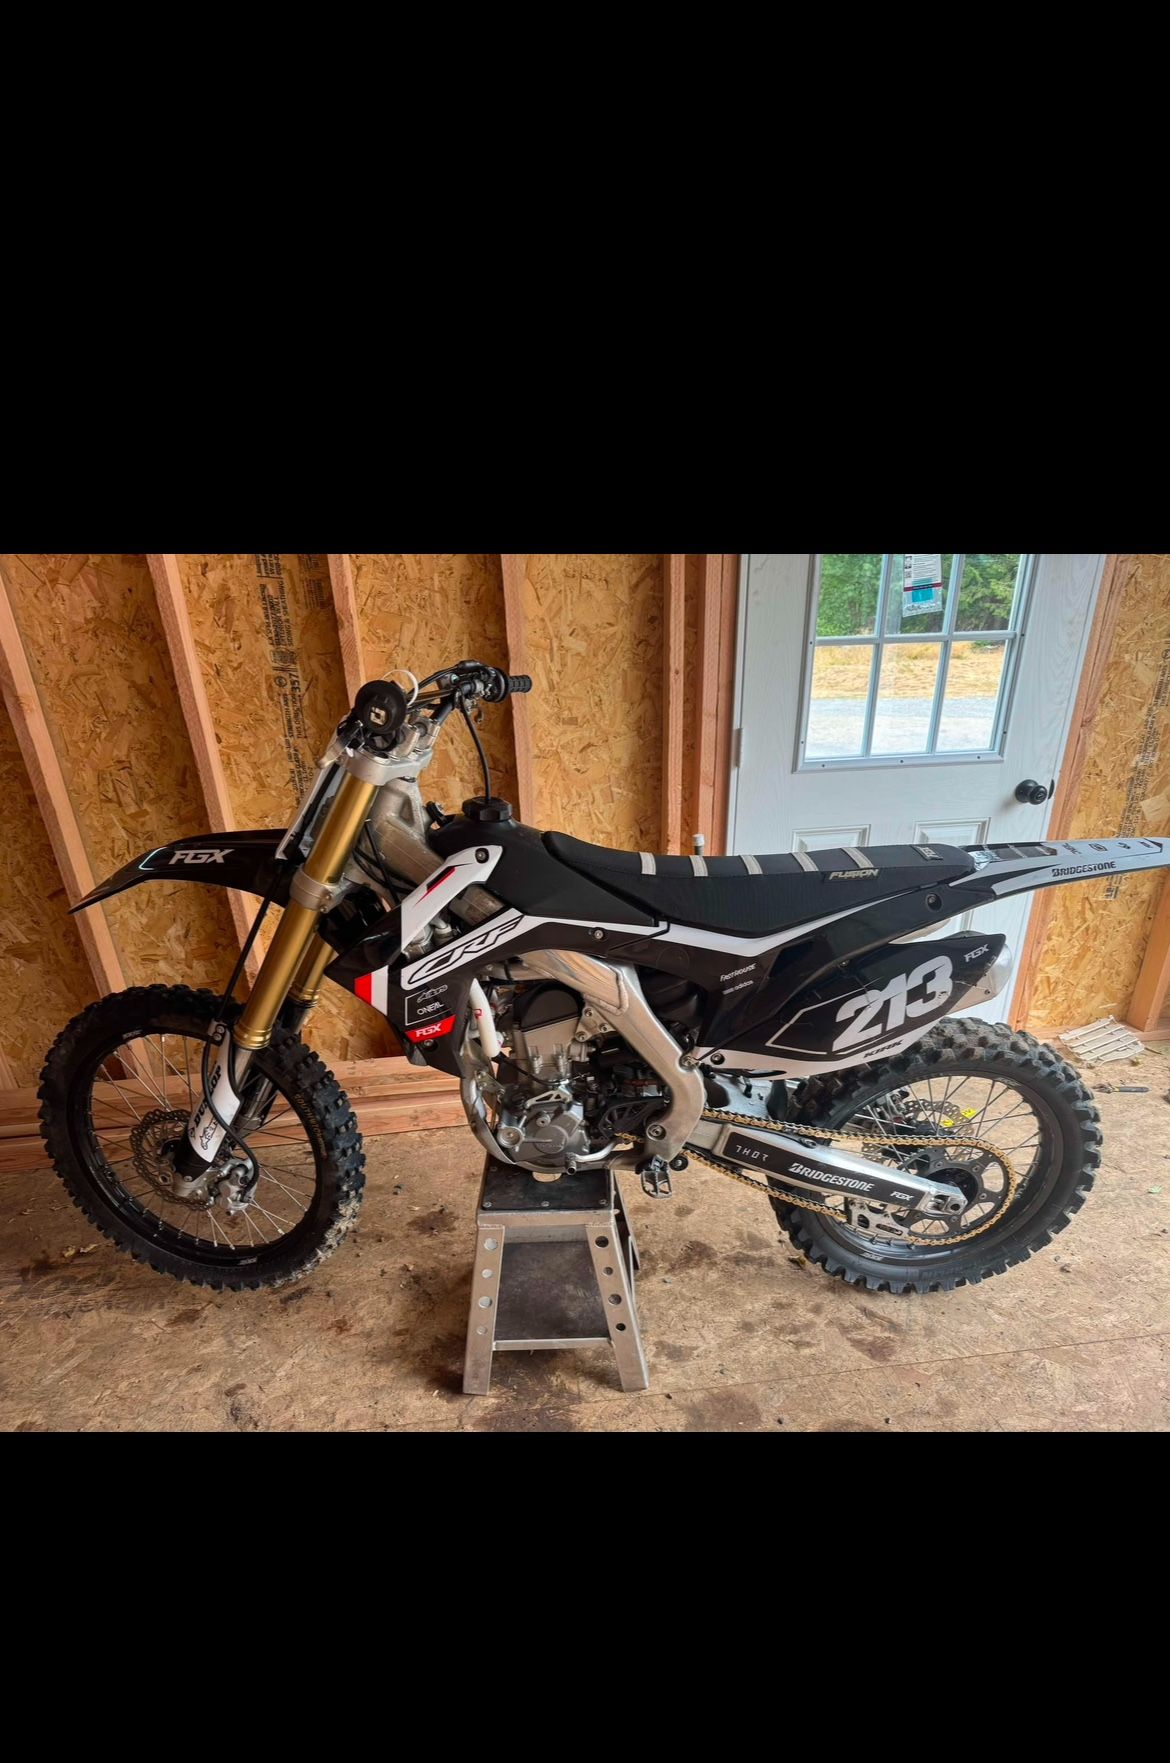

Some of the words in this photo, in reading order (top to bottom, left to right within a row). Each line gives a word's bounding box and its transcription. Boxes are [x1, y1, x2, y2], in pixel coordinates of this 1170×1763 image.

[289, 673, 300, 693] 357
[168, 849, 235, 864] FGX
[1051, 861, 1117, 877] BRIDGESTONE
[407, 914, 525, 985] CRF
[963, 944, 990, 962] FGX
[832, 955, 953, 1052] 213
[415, 1022, 442, 1037] FGX
[788, 1162, 875, 1192] BRIDGESTONE
[890, 1190, 915, 1201] FGX
